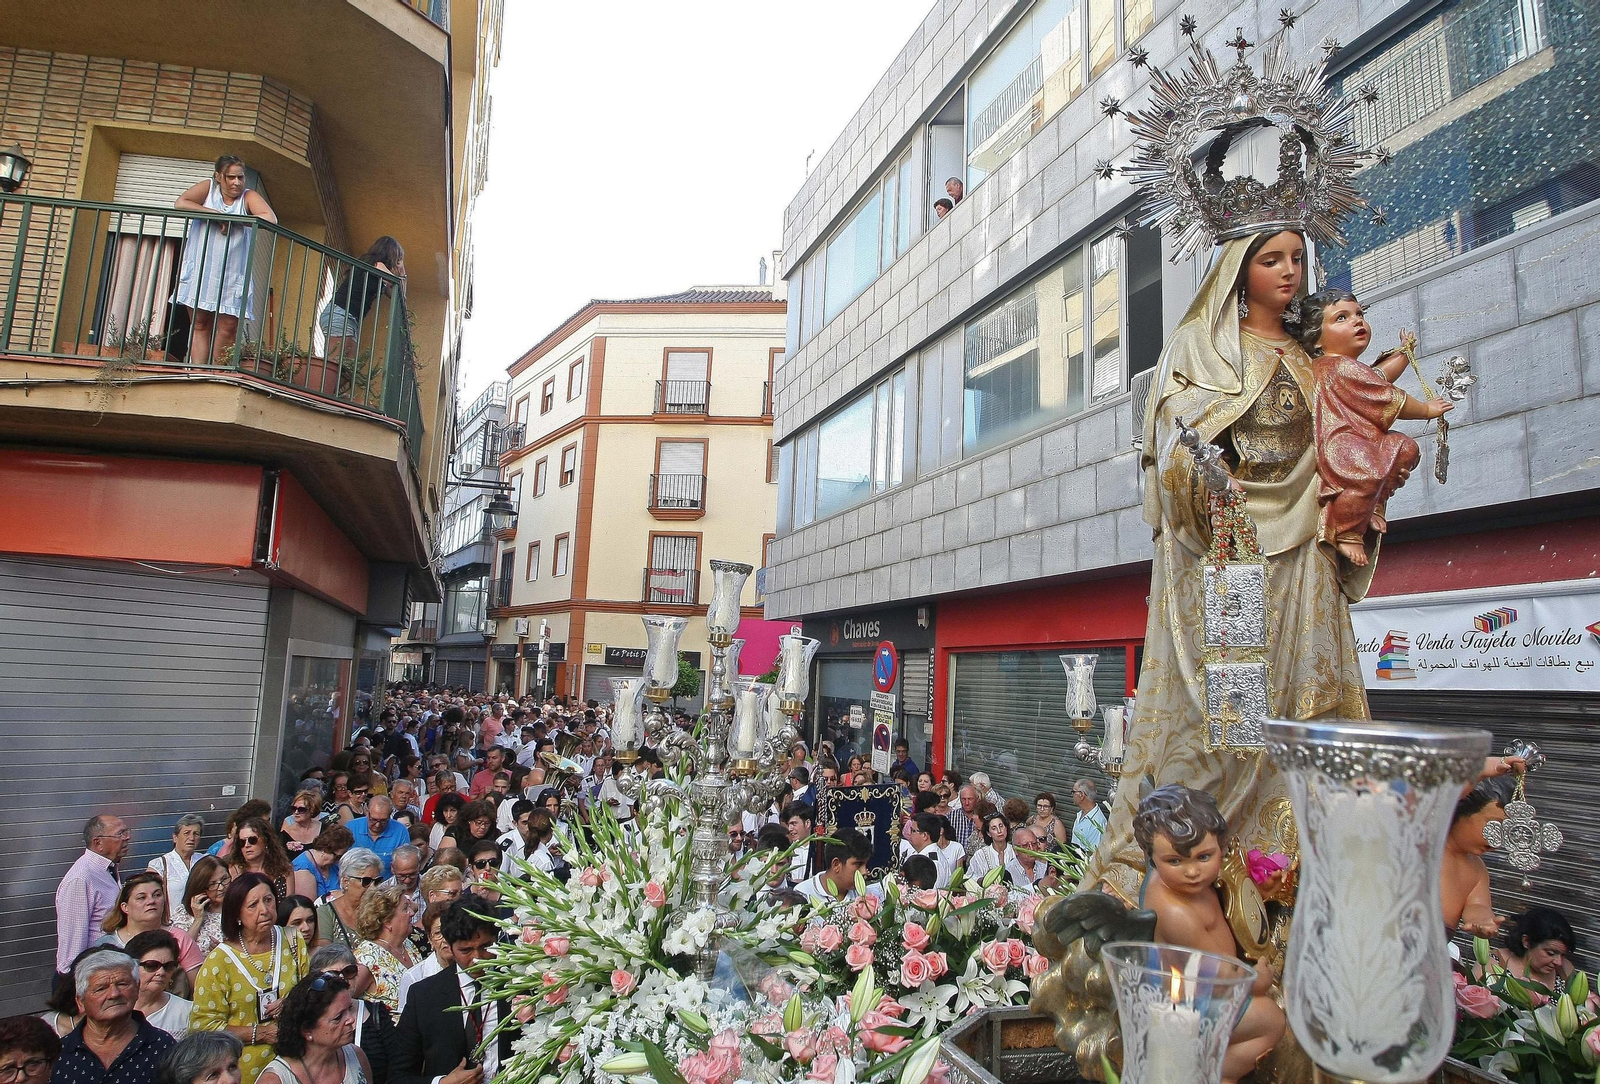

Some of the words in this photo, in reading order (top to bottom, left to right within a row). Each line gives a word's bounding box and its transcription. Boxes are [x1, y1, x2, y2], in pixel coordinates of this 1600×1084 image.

[843, 618, 881, 640] Chaves
[1415, 632, 1455, 651] Venta
[1460, 630, 1517, 655] Tarjeta
[1522, 626, 1583, 648] Moviles
[610, 649, 620, 657] Le
[620, 649, 640, 658] Petit
[1460, 656, 1500, 672] للهواتف
[1535, 655, 1571, 670] بطاقات
[1575, 660, 1595, 673] بيع
[927, 647, 935, 721] Mayoristas
